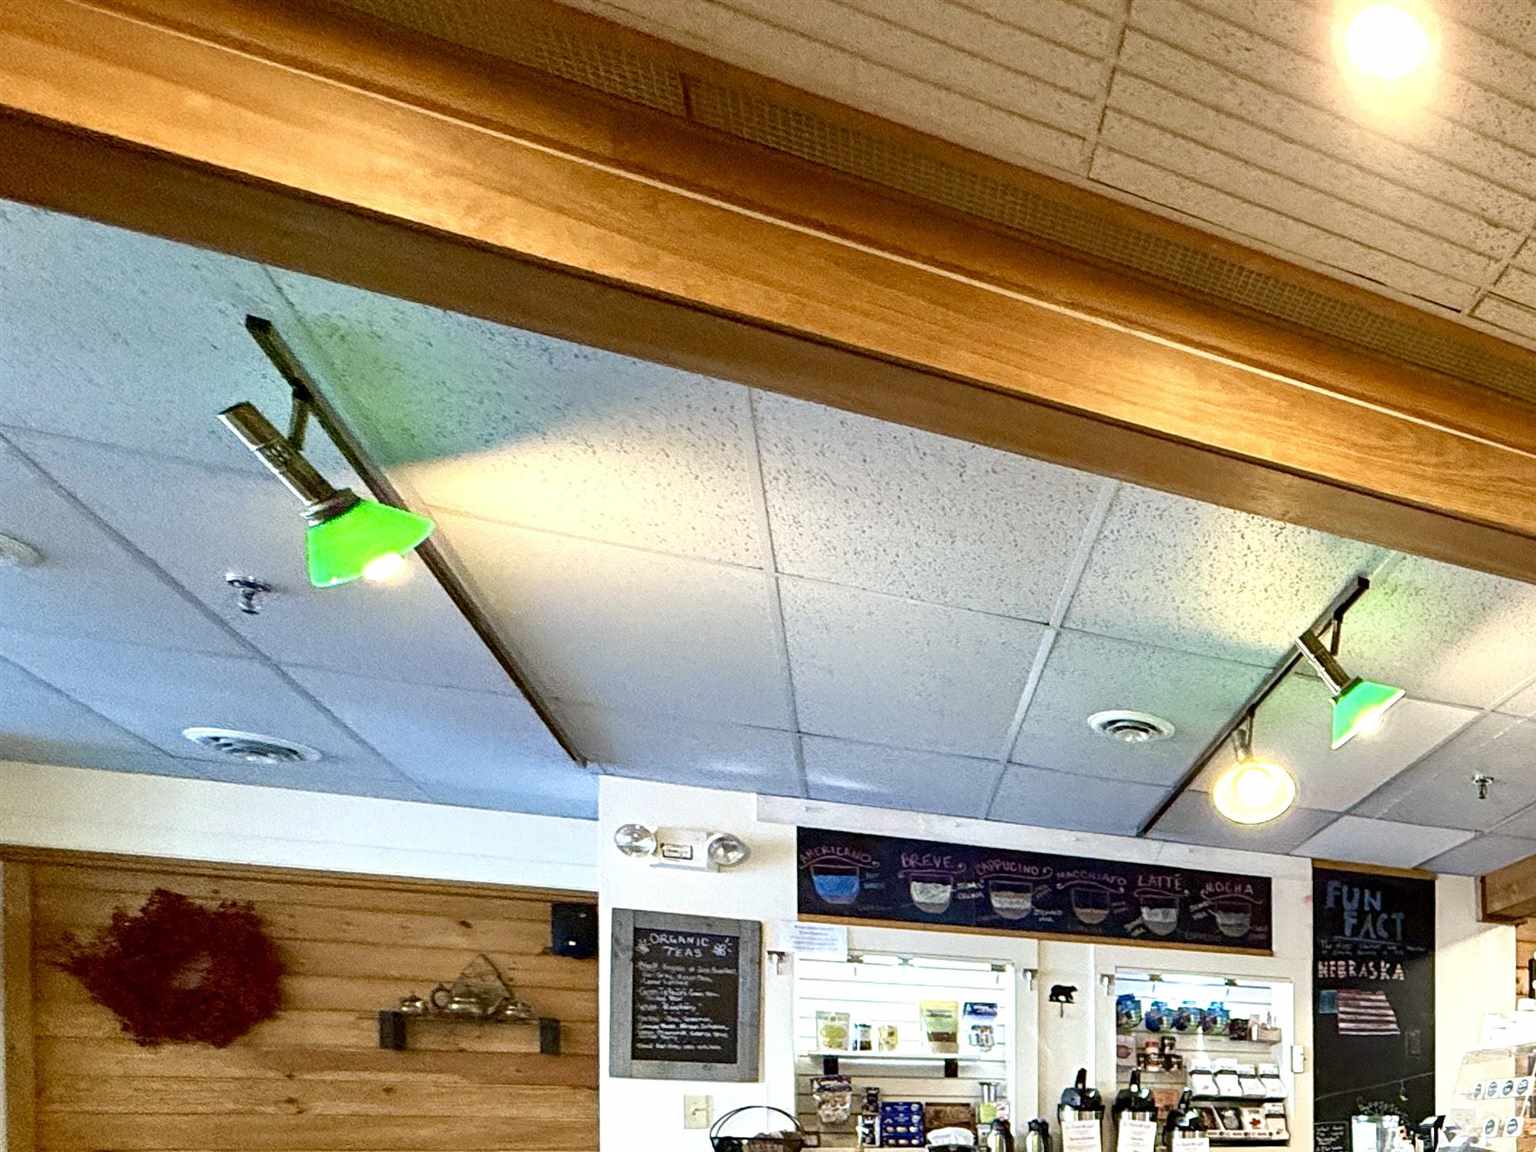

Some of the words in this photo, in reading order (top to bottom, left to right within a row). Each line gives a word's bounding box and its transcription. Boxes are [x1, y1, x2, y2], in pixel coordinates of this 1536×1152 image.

[800, 845, 872, 865] AMERICANO
[900, 852, 953, 869] BREVE
[974, 858, 1040, 877] CAPPUCINO
[1056, 868, 1128, 886] MACCHIATO
[1205, 881, 1255, 896] MOCHA
[1326, 880, 1382, 912] FUN
[1343, 911, 1406, 941] FACT
[649, 932, 711, 947] ORGANIC
[662, 946, 704, 958] TEAS
[1317, 959, 1406, 981] NEBRASKA
